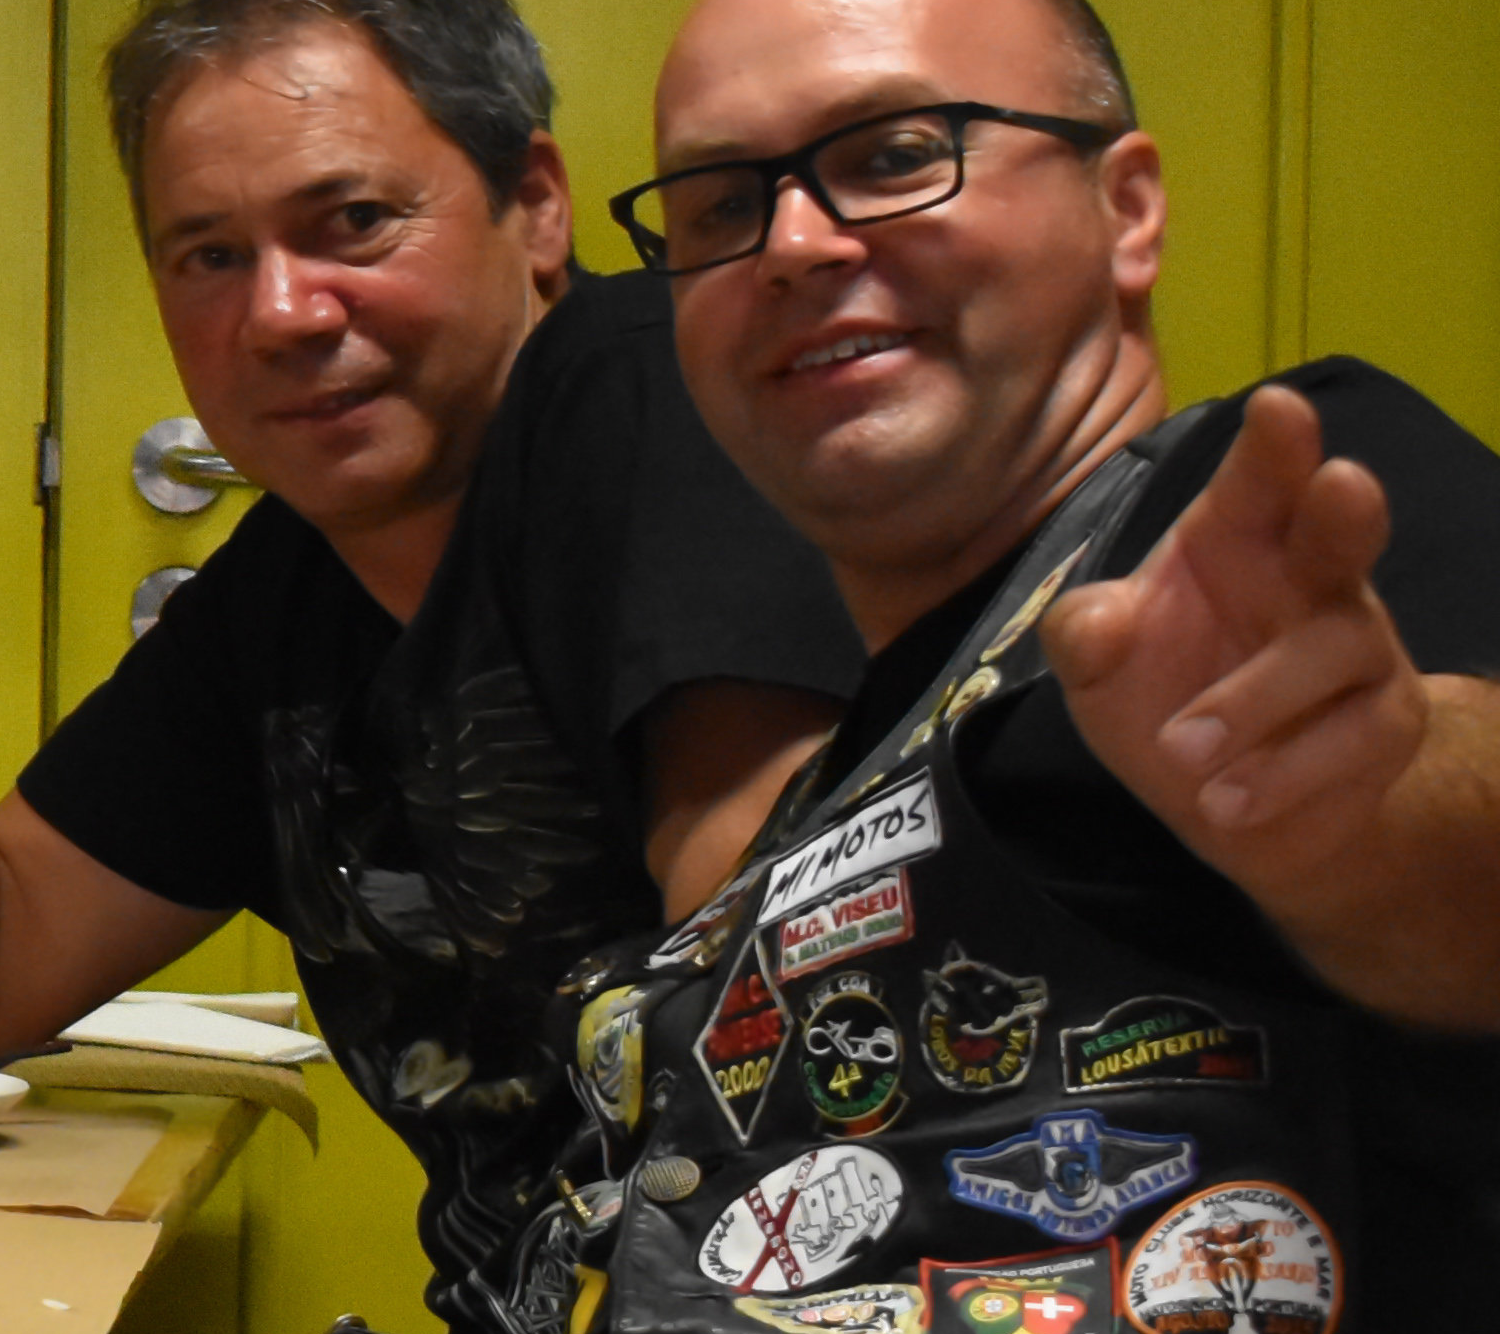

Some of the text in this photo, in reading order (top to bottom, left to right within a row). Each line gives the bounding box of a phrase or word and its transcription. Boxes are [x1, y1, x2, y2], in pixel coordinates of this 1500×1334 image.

[810, 784, 932, 886] MOTOS
[832, 884, 900, 929] VISEU
[1080, 1010, 1192, 1057] RESERVA
[1145, 1209, 1195, 1254] CLUBE
[1202, 1189, 1312, 1229] HORIZONTE
